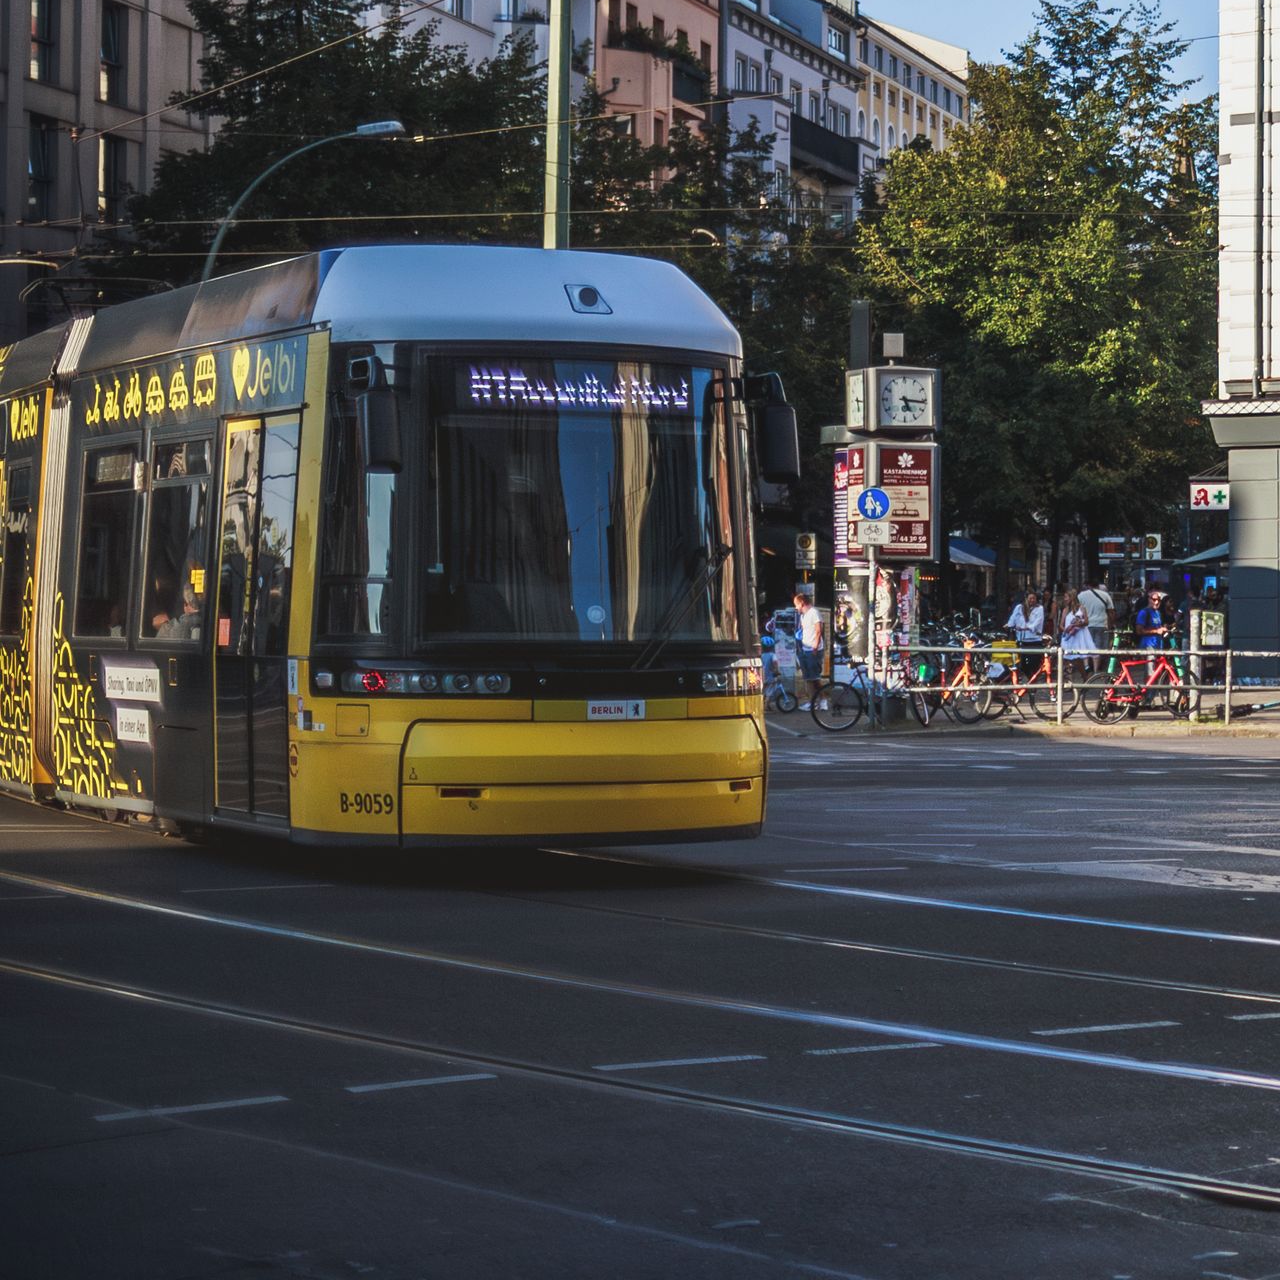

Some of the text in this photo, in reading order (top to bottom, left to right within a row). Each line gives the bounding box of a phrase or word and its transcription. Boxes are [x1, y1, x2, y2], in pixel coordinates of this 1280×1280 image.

[248, 341, 299, 399] Jelbi
[591, 706, 623, 715] BERLIN
[340, 793, 394, 815] B-9059
